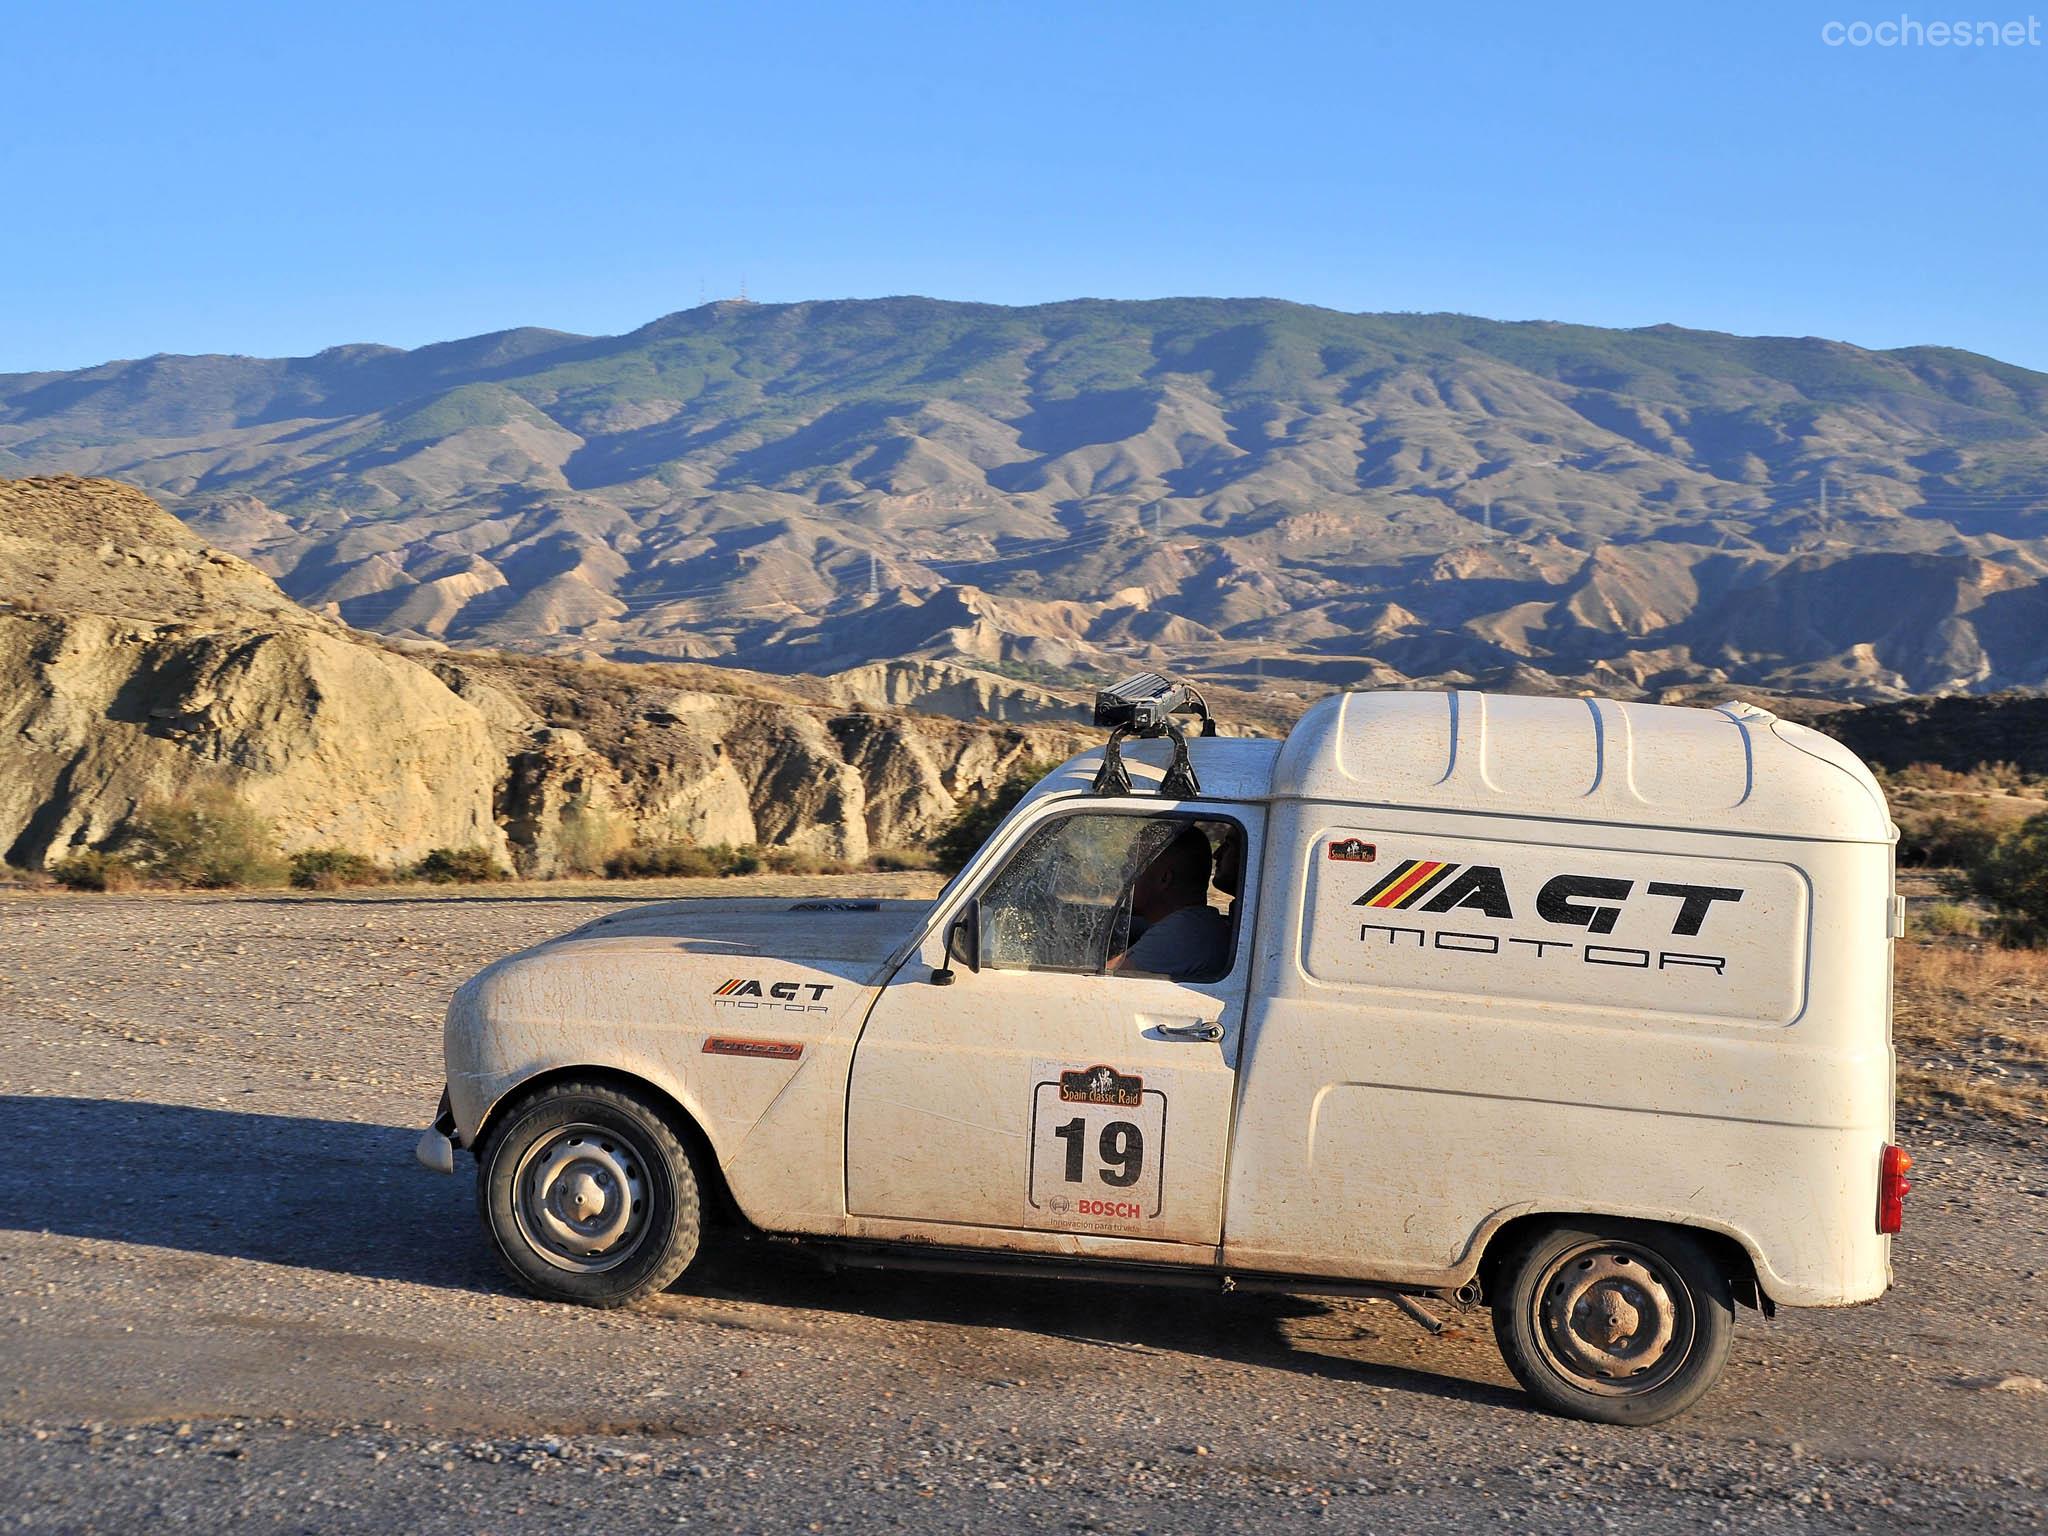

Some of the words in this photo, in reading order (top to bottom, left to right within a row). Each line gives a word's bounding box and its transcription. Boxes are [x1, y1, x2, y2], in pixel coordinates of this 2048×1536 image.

[1417, 865, 1745, 938] AGT
[1359, 924, 1727, 976] MOTOR
[733, 980, 834, 1001] AGT
[714, 1000, 828, 1014] MOTOR
[1062, 1084, 1087, 1102] Spain
[1117, 1088, 1138, 1105] Raid
[1054, 1117, 1144, 1188] 19
[1078, 1199, 1140, 1219] BOSCH
